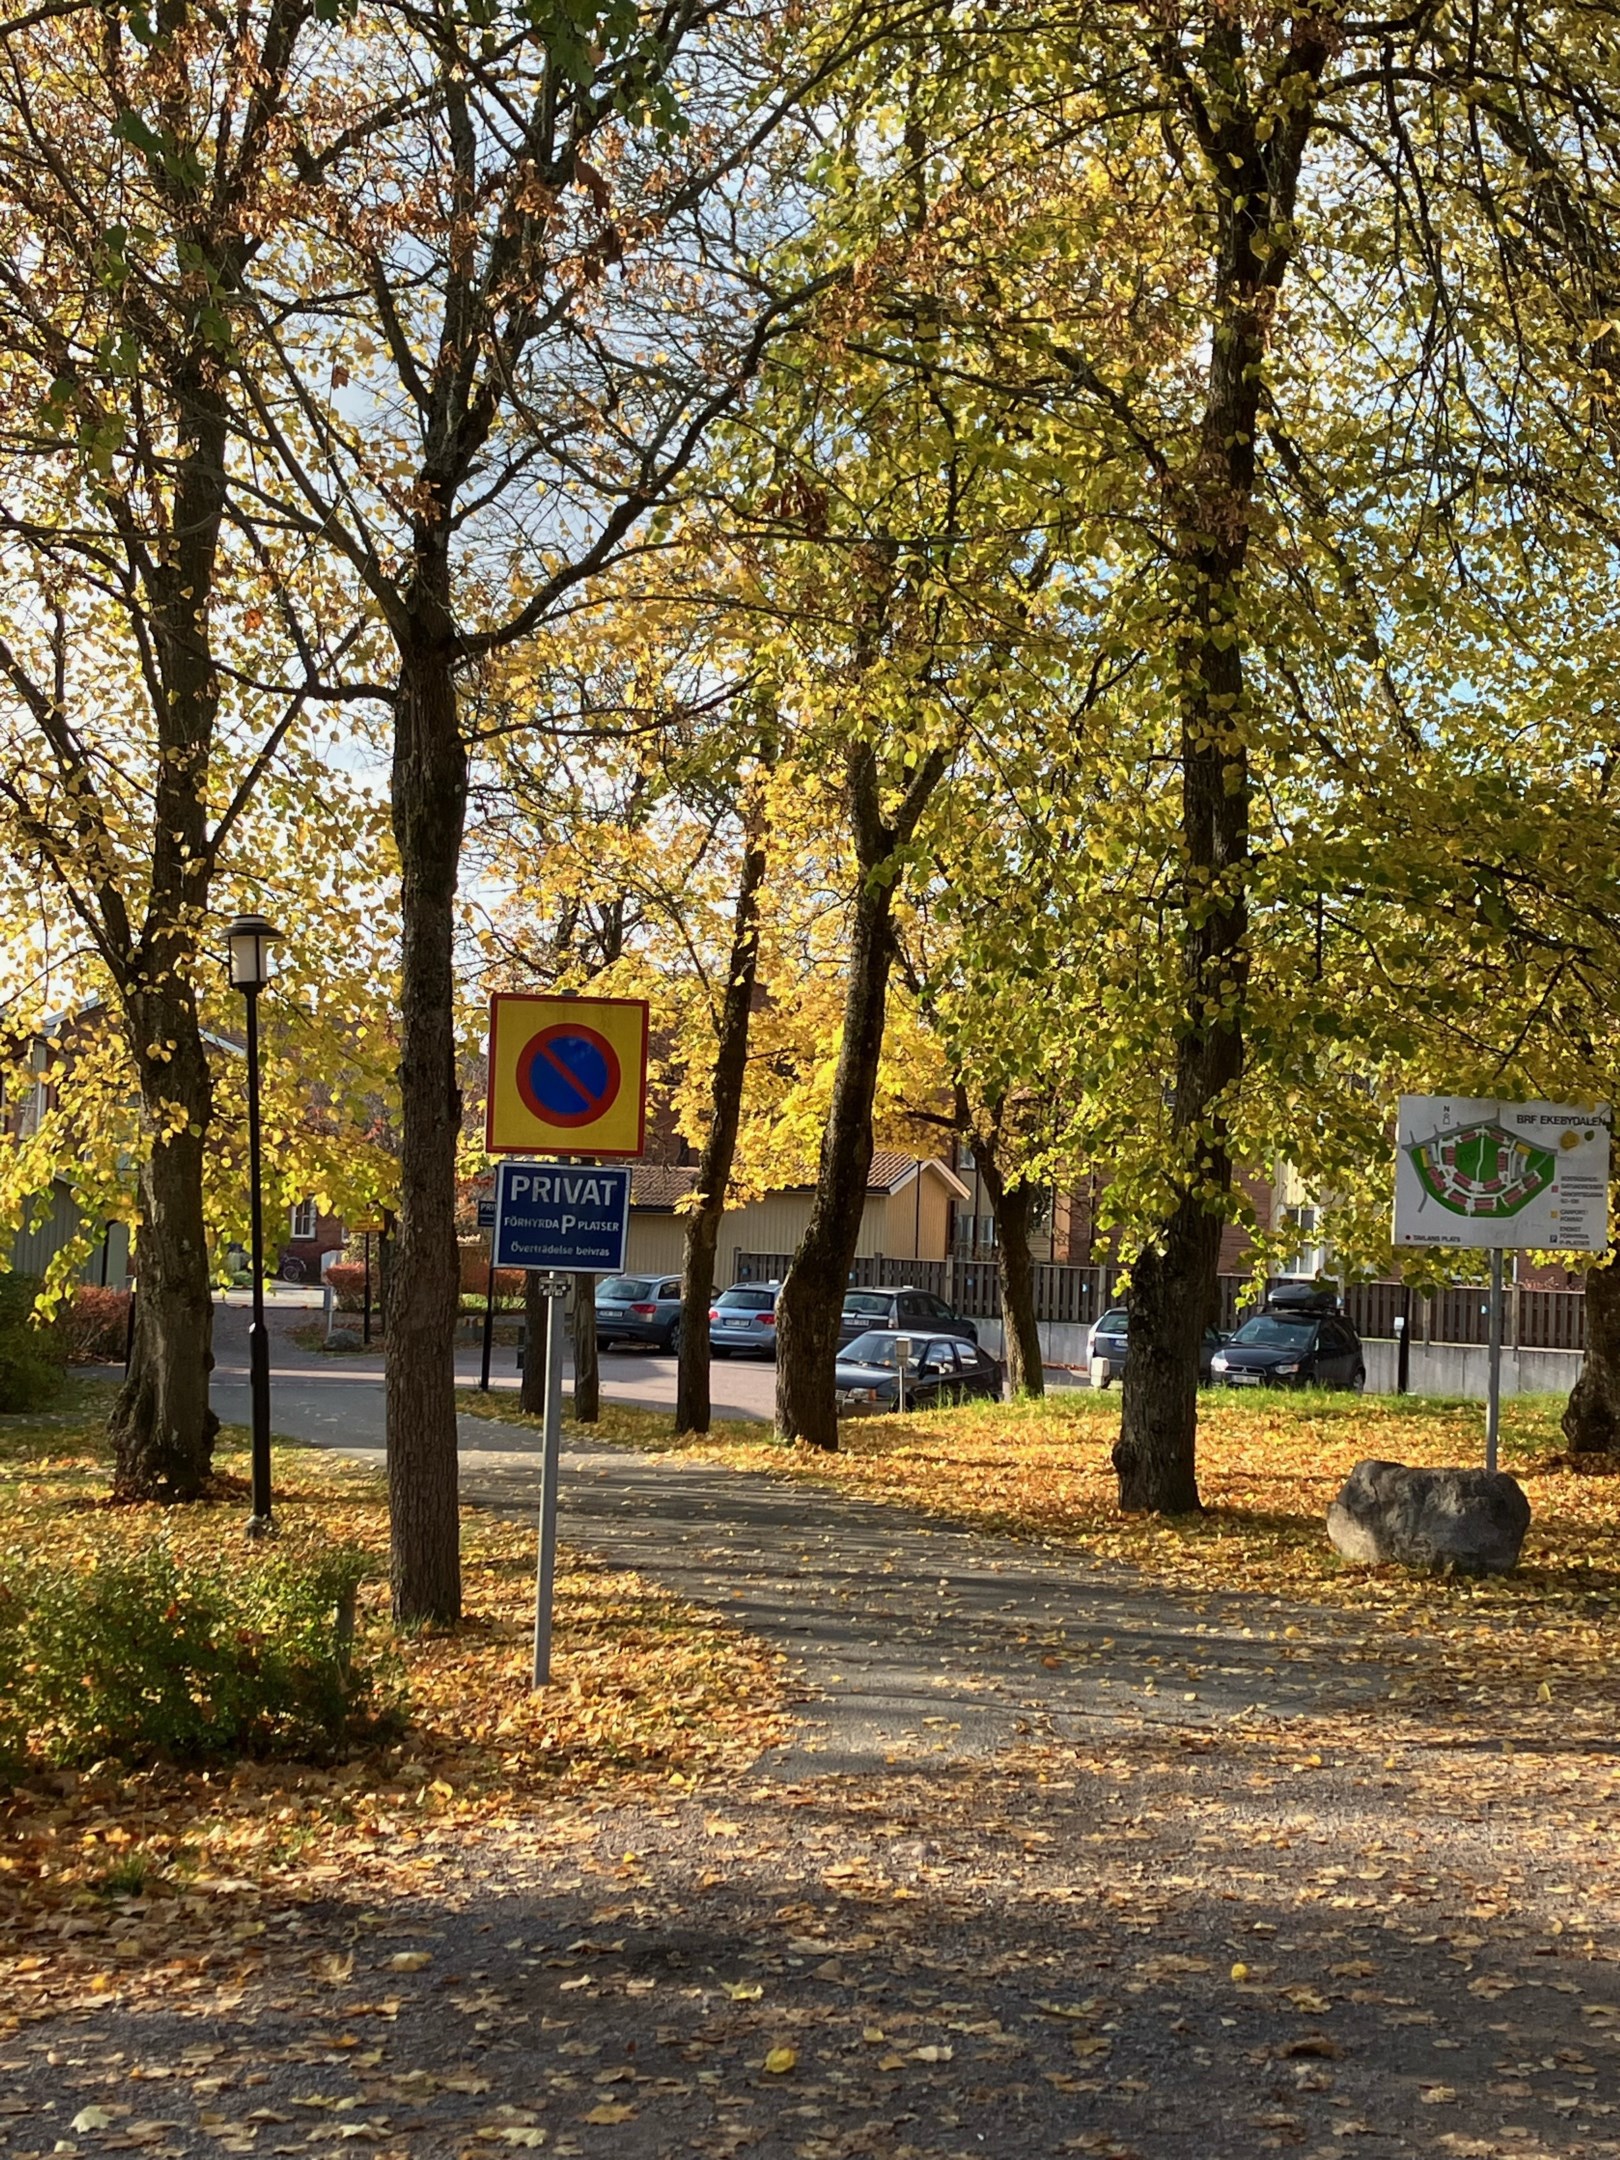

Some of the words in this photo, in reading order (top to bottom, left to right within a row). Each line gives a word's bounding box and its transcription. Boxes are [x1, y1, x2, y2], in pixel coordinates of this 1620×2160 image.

[1516, 1114, 1538, 1124] BRF
[1540, 1115, 1606, 1127] EKEBYDALEN
[510, 1175, 618, 1206] PRIVAT
[504, 1216, 560, 1229] FÖRHYRDA
[561, 1214, 576, 1235] P
[577, 1220, 620, 1232] PLATSER
[510, 1240, 573, 1256] Överträdelse
[575, 1245, 610, 1257] beivras
